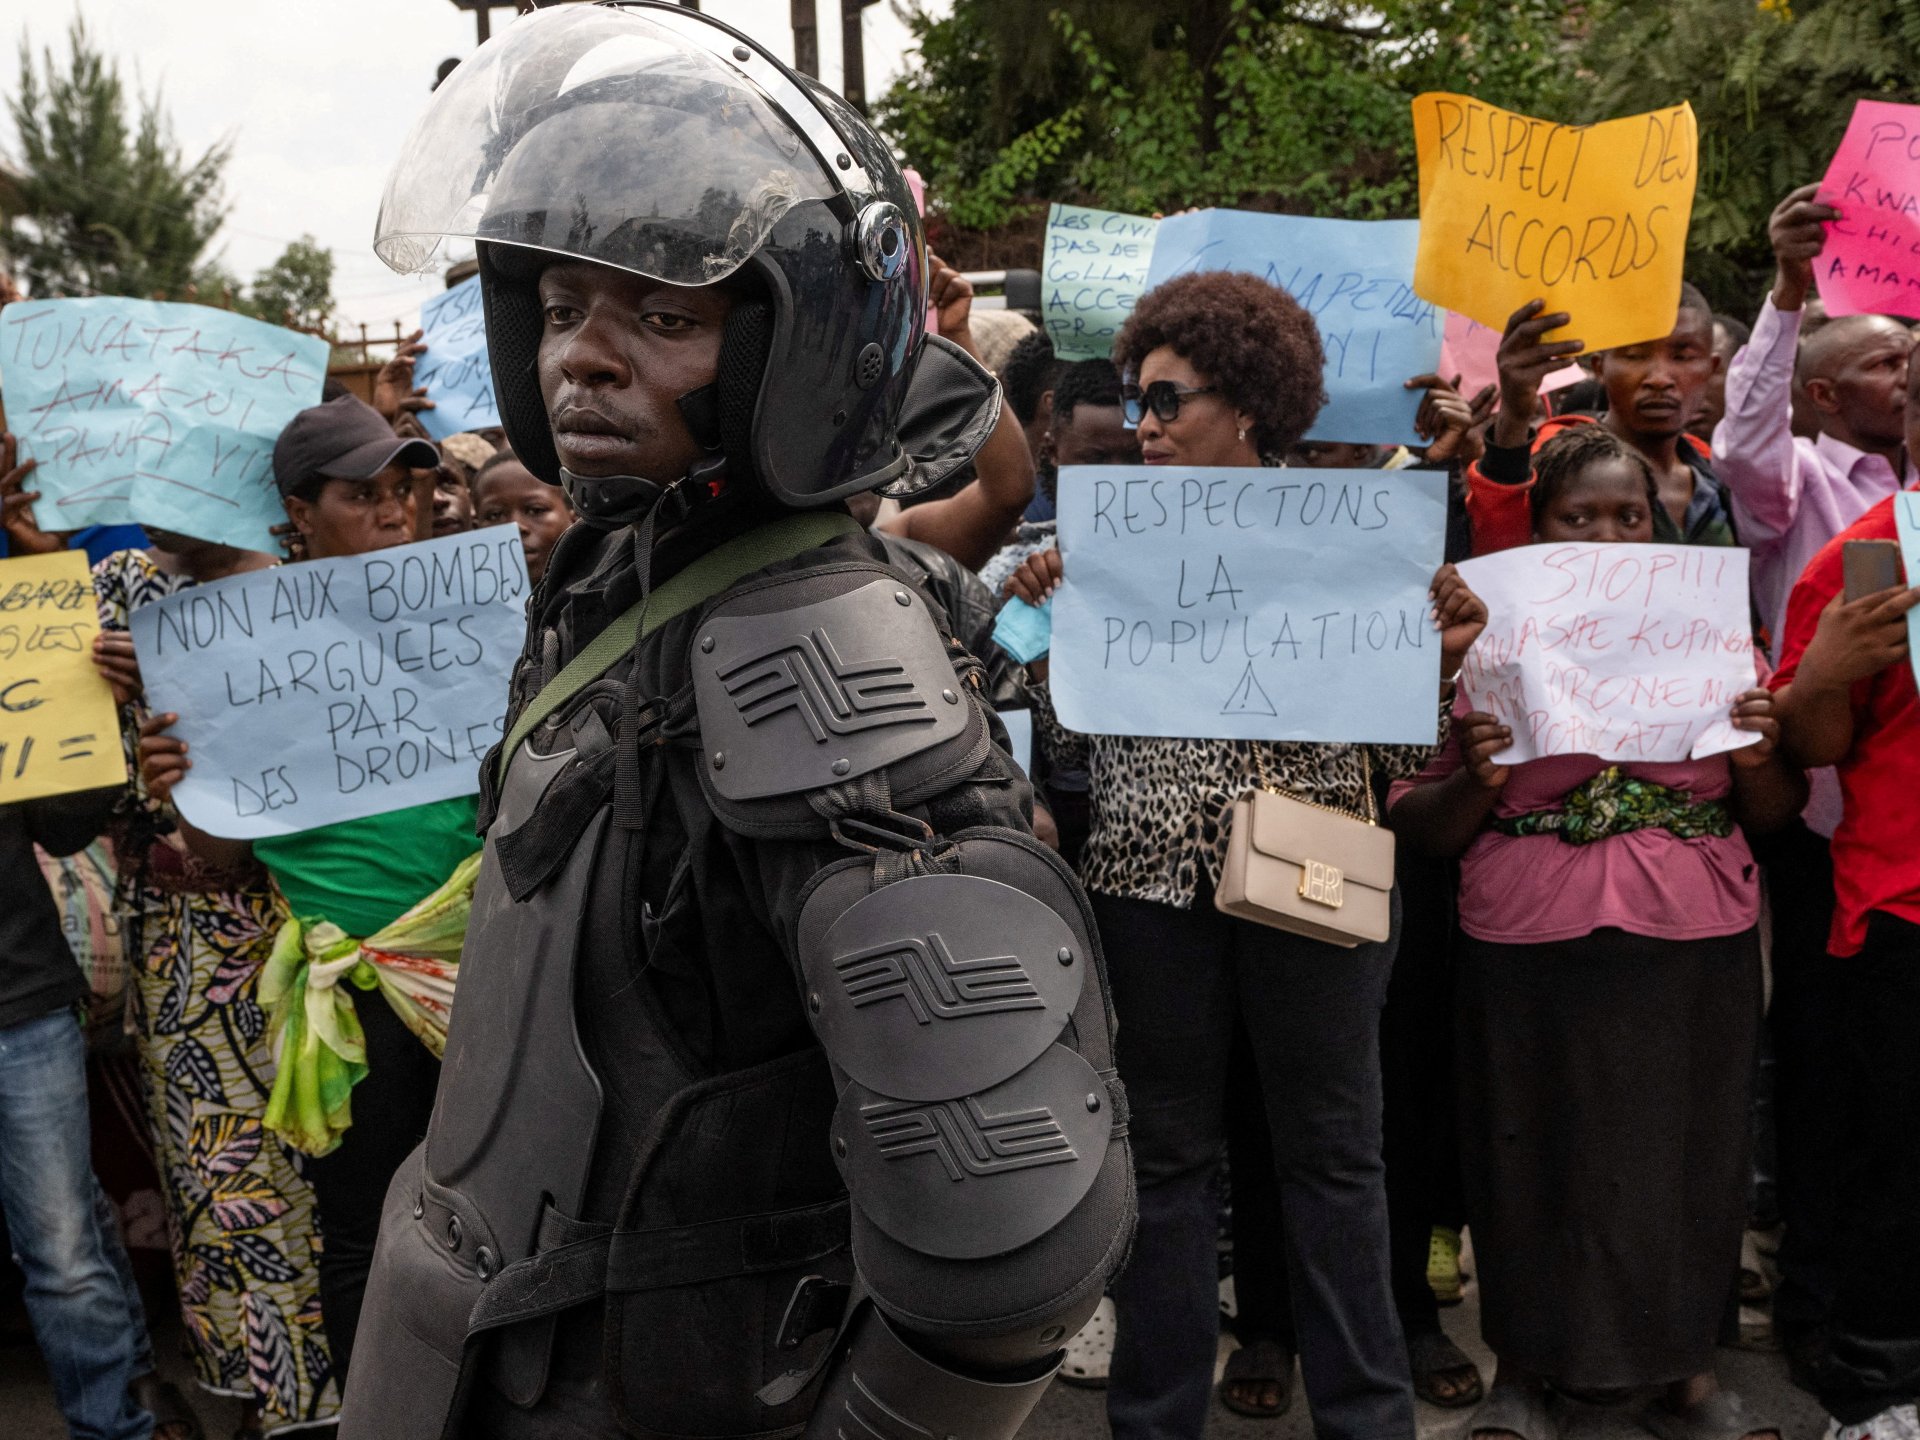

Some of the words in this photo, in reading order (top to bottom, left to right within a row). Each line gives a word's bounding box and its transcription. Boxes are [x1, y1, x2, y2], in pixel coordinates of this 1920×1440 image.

[1436, 100, 1598, 202] RESPECT
[1634, 109, 1692, 188] DES
[1051, 203, 1092, 230] LES
[1844, 172, 1919, 216] KWA
[1051, 235, 1100, 259] PAS
[1109, 242, 1139, 258] DE
[1466, 204, 1669, 287] ACCORDS
[9, 308, 319, 395] TUNATAKA
[1046, 317, 1126, 338] PRO
[421, 356, 490, 390] TUN
[1093, 479, 1391, 538] RESPECTONS
[157, 588, 254, 655] NON
[270, 568, 340, 631] AUX
[364, 537, 524, 623] BOMBES
[1177, 554, 1244, 611] LA
[224, 615, 483, 706] LARGUEES
[1103, 607, 1427, 669] POPULATION
[327, 688, 437, 751] PAR
[230, 765, 298, 817] DES
